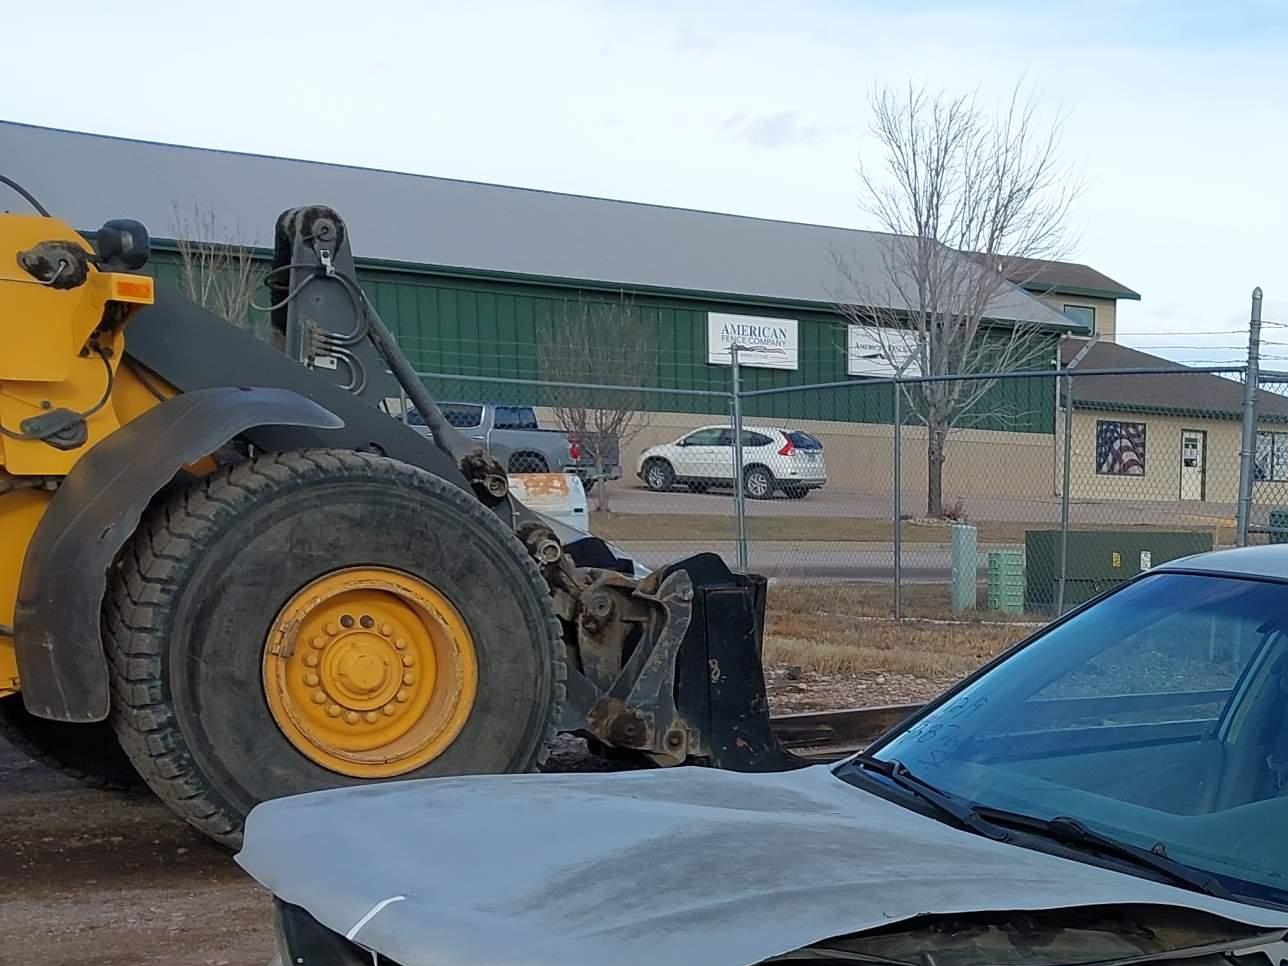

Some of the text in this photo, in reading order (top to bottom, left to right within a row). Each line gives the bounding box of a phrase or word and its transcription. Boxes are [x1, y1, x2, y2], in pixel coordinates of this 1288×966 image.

[721, 322, 787, 340] AMERICAN
[721, 335, 787, 347] FENCE COMPANY
